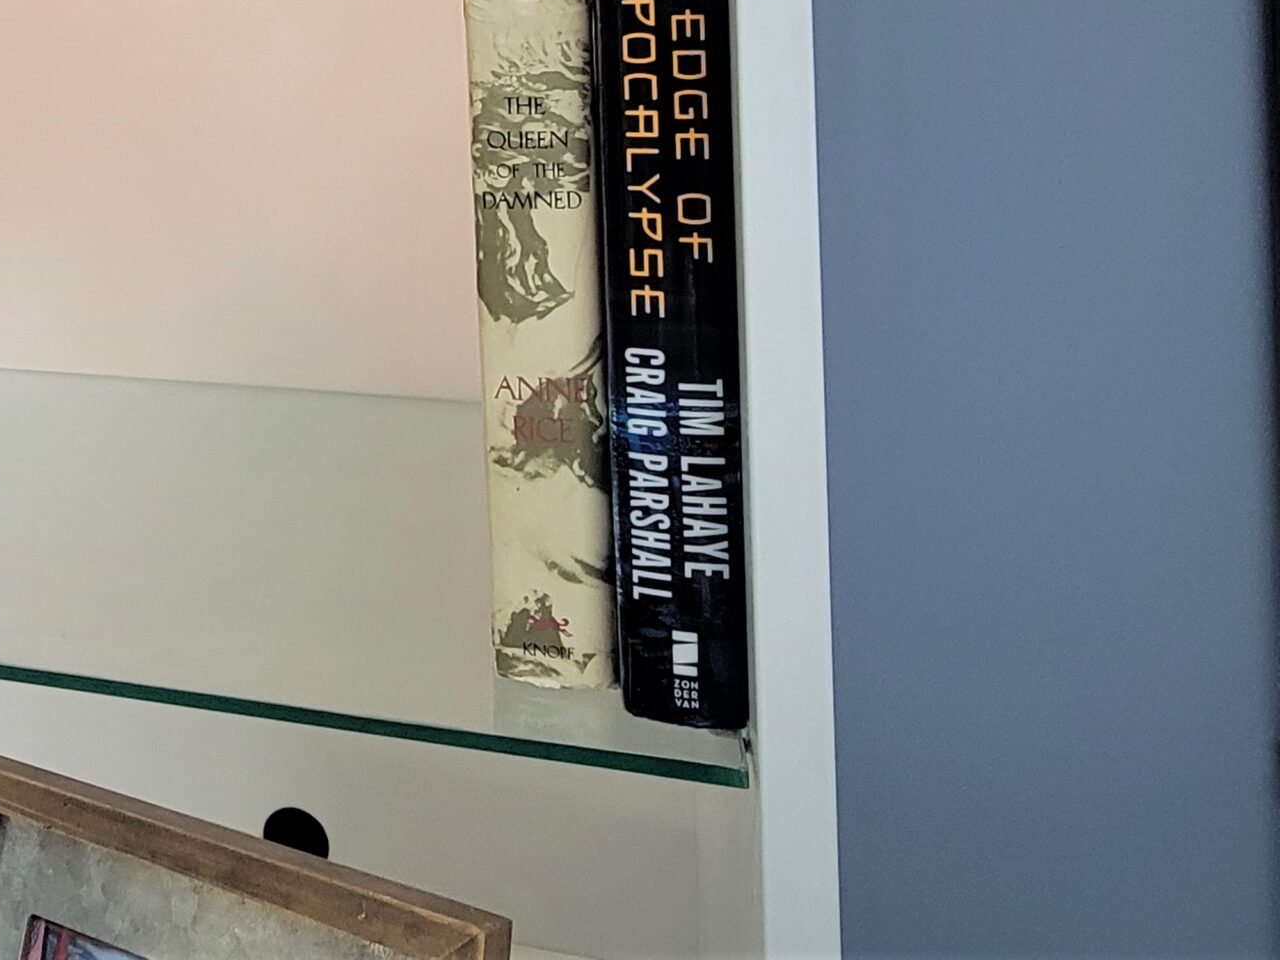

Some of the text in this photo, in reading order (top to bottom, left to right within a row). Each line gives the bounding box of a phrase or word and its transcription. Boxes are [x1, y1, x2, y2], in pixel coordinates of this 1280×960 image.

[504, 96, 546, 115] THE
[486, 130, 569, 151] QUEEN
[671, 9, 713, 264] EDGE OF
[496, 162, 566, 178] OF THE
[482, 190, 582, 210] DAMNED
[494, 375, 588, 402] ANNE
[511, 416, 571, 443] RICE
[624, 347, 673, 600] CRAIG PARSHALL
[677, 379, 730, 580] TIM LAHAYE
[522, 642, 575, 660] KNOPF
[674, 678, 699, 689] ZON
[674, 689, 699, 699] DER
[674, 699, 700, 709] VAN
